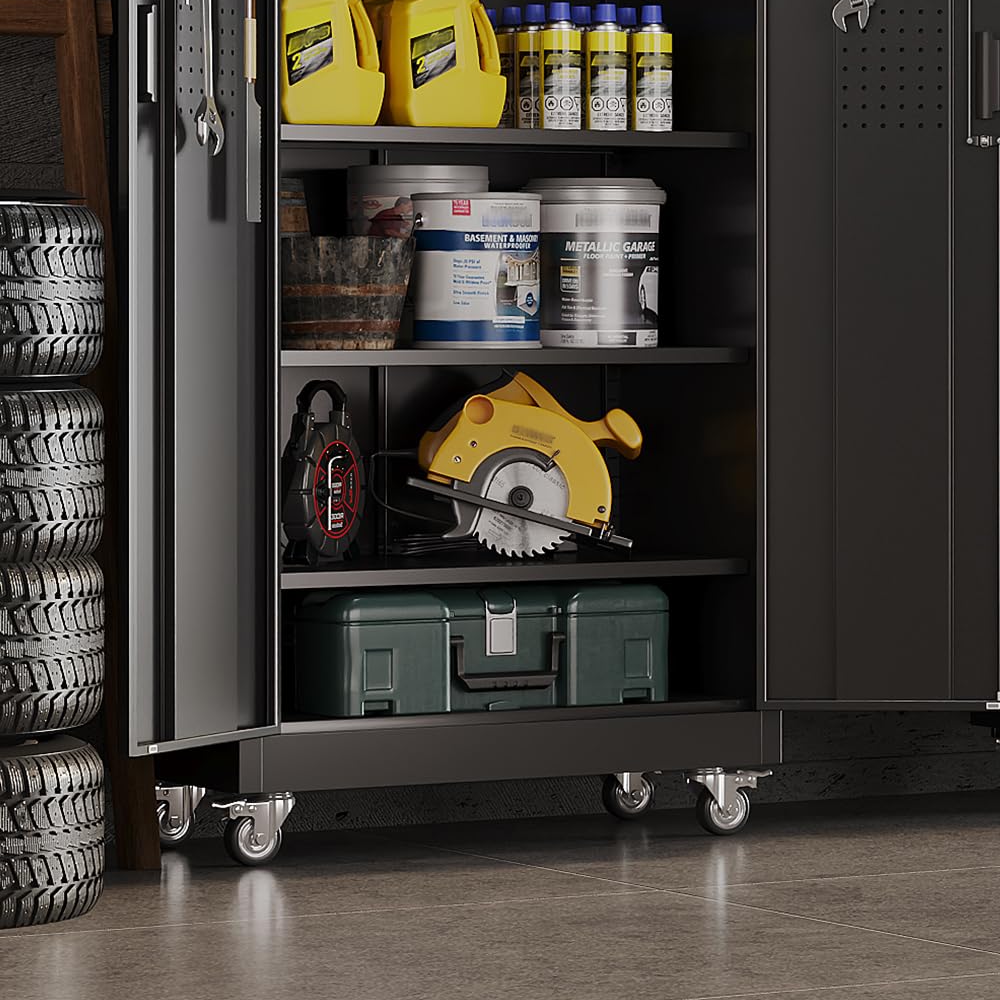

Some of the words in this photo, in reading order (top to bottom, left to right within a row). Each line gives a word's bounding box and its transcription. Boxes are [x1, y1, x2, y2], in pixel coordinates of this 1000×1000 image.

[292, 53, 302, 71] 2
[416, 56, 427, 74] 2
[464, 233, 508, 243] BASEMENT
[509, 234, 515, 242] &
[565, 241, 620, 252] METALLIC
[623, 241, 656, 252] GARAGE
